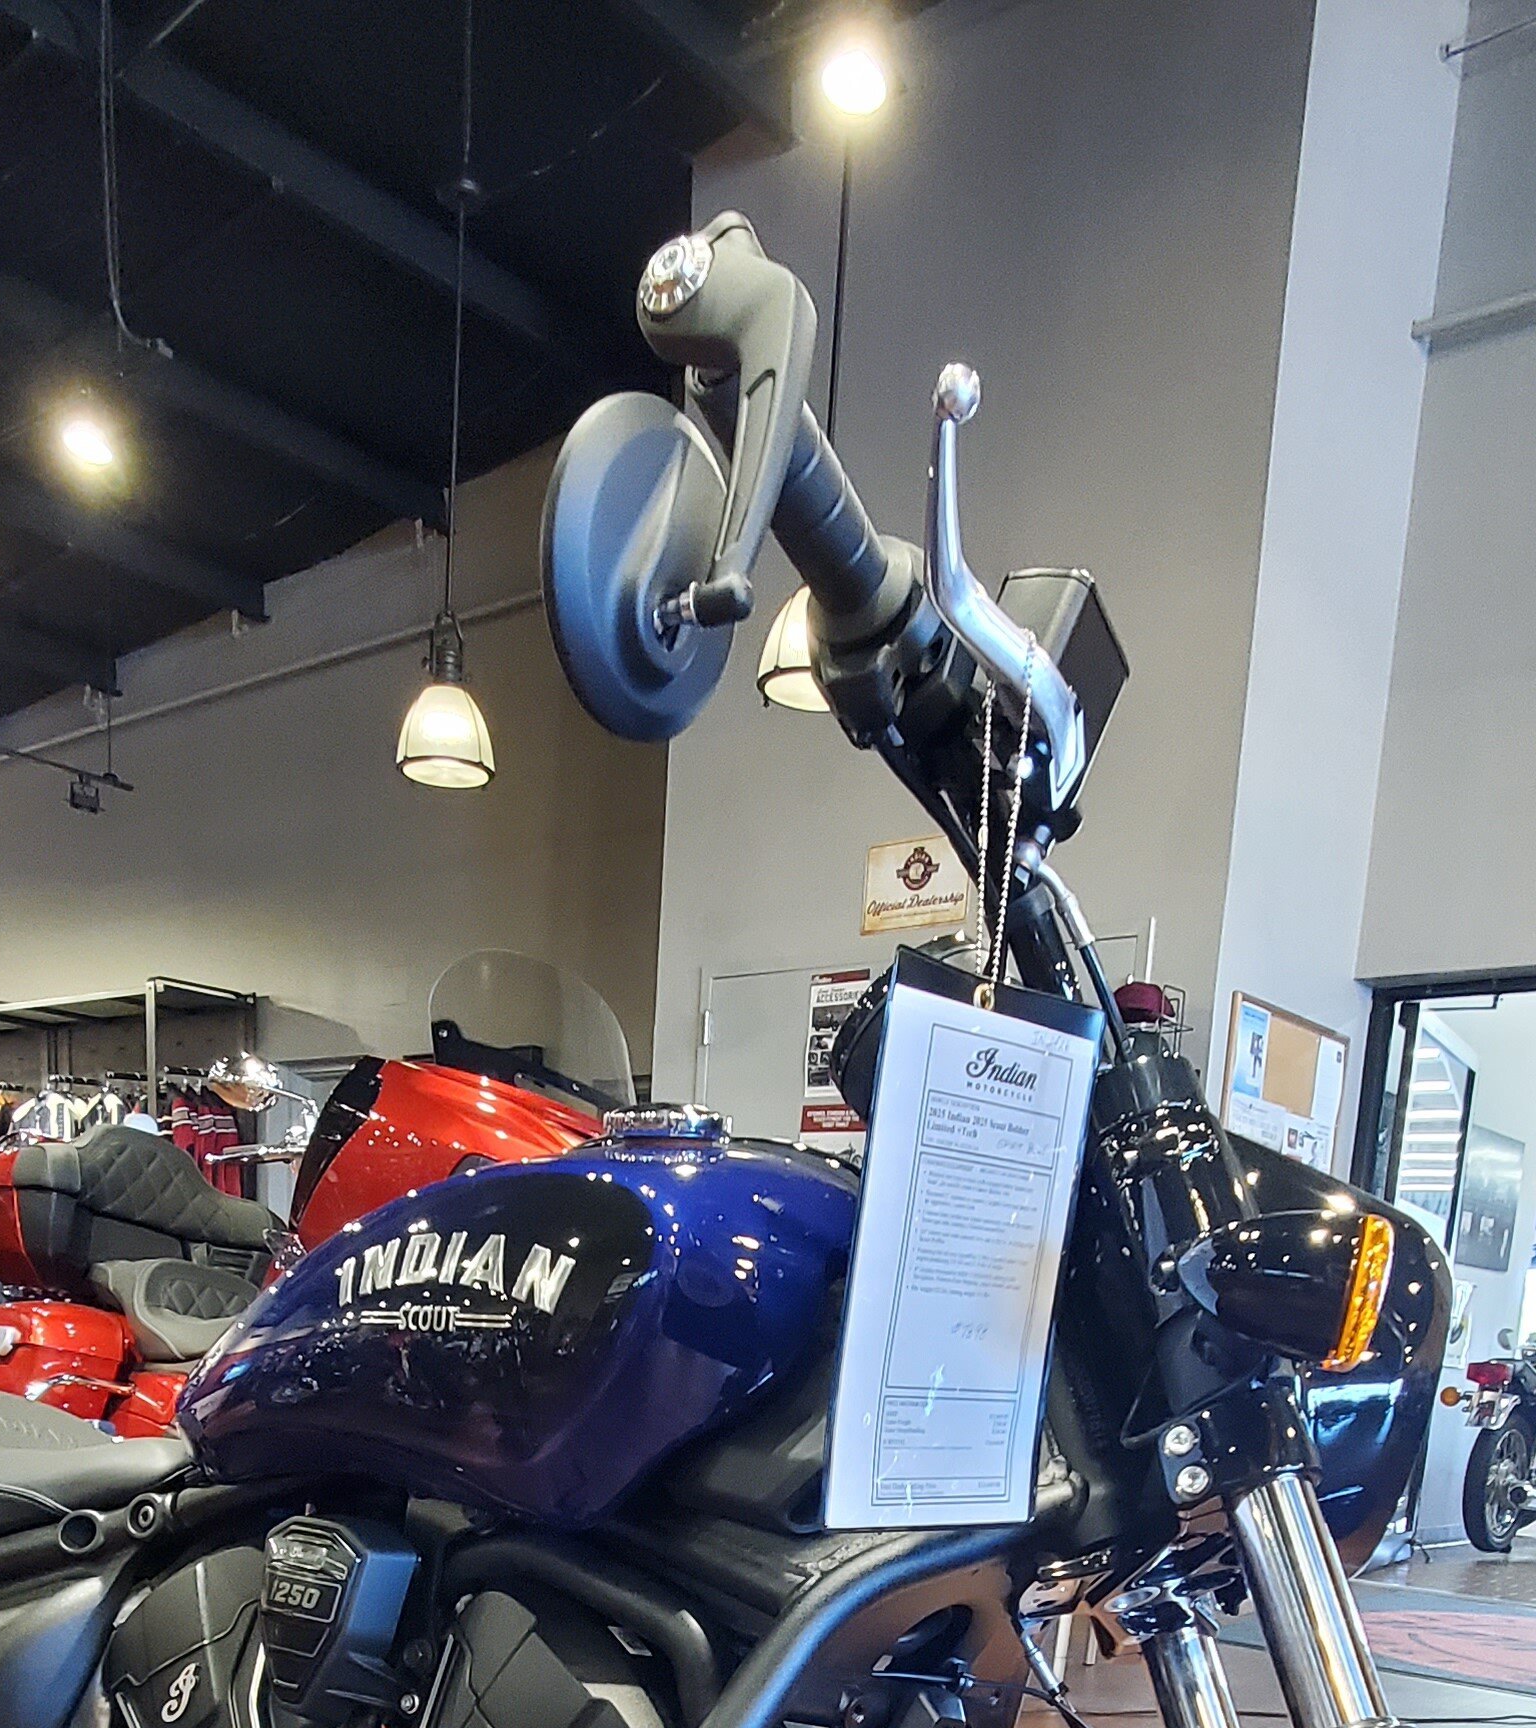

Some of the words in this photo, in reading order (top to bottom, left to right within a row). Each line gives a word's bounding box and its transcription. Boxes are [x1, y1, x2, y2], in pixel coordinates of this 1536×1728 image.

[867, 900, 908, 917] Official
[906, 893, 965, 909] Dealership
[966, 1047, 1037, 1091] Indian
[966, 1081, 1033, 1102] MOTORCYCLE
[927, 1119, 956, 1135] Limited
[929, 1106, 945, 1119] 2025
[947, 1110, 971, 1124] Indian
[972, 1114, 989, 1127] 2025
[339, 1231, 576, 1316] INDIAN
[398, 1303, 461, 1332] SCOUT
[270, 1577, 321, 1610] 1250
